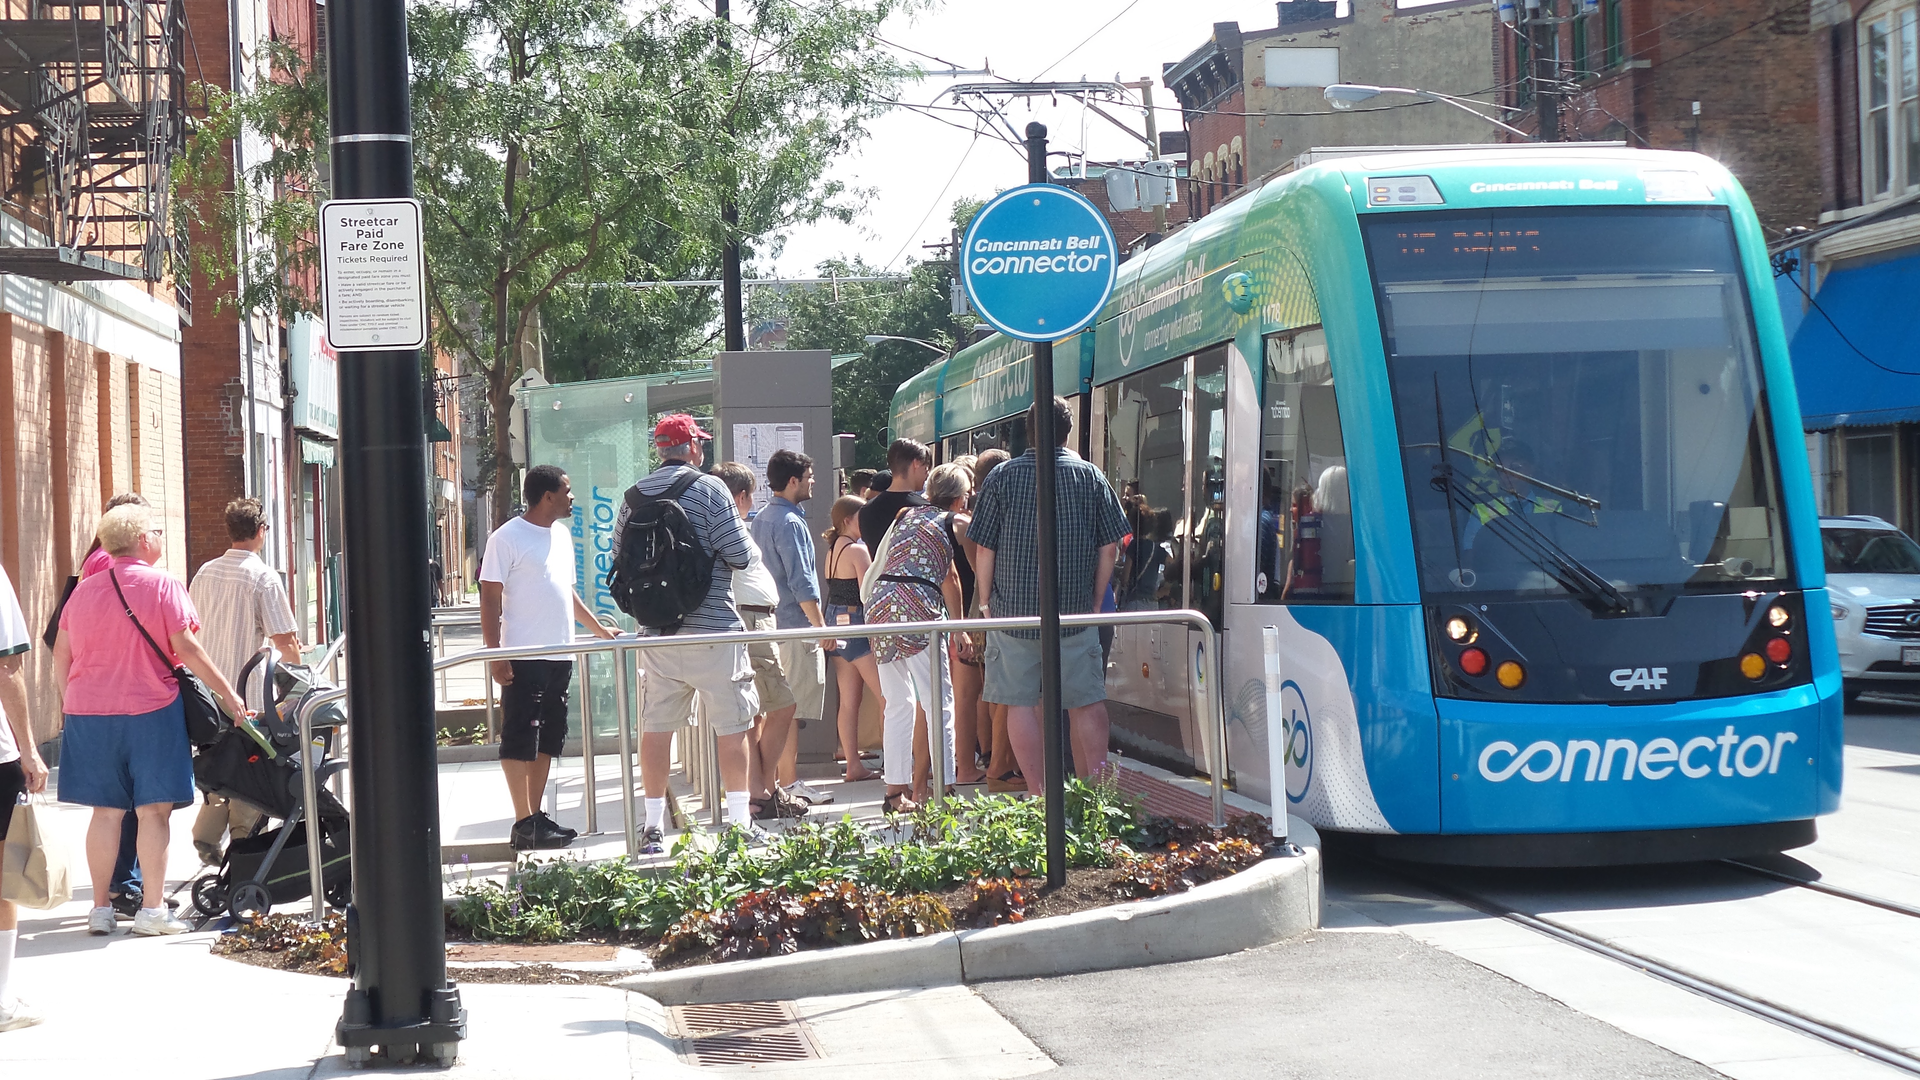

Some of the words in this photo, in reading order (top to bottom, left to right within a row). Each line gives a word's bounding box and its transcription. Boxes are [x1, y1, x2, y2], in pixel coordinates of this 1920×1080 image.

[1470, 180, 1574, 193] Cincinnati
[340, 217, 399, 227] Streetcar
[356, 228, 383, 239] Paid
[340, 241, 368, 251] Fare
[372, 240, 405, 251] Zone
[974, 238, 1063, 252] Cincinnati
[1066, 235, 1101, 250] Bell
[337, 256, 367, 264] Tickets
[369, 255, 408, 264] Required
[971, 251, 1108, 275] connector
[1136, 270, 1183, 322] Cincinnati
[1183, 253, 1207, 300] Bell
[1262, 302, 1281, 325] 1178
[1144, 319, 1170, 351] connecting
[1170, 312, 1182, 341] what
[1182, 309, 1203, 336] matters
[571, 505, 584, 539] Bell
[1609, 667, 1668, 691] CAF
[1478, 725, 1798, 783] connector
